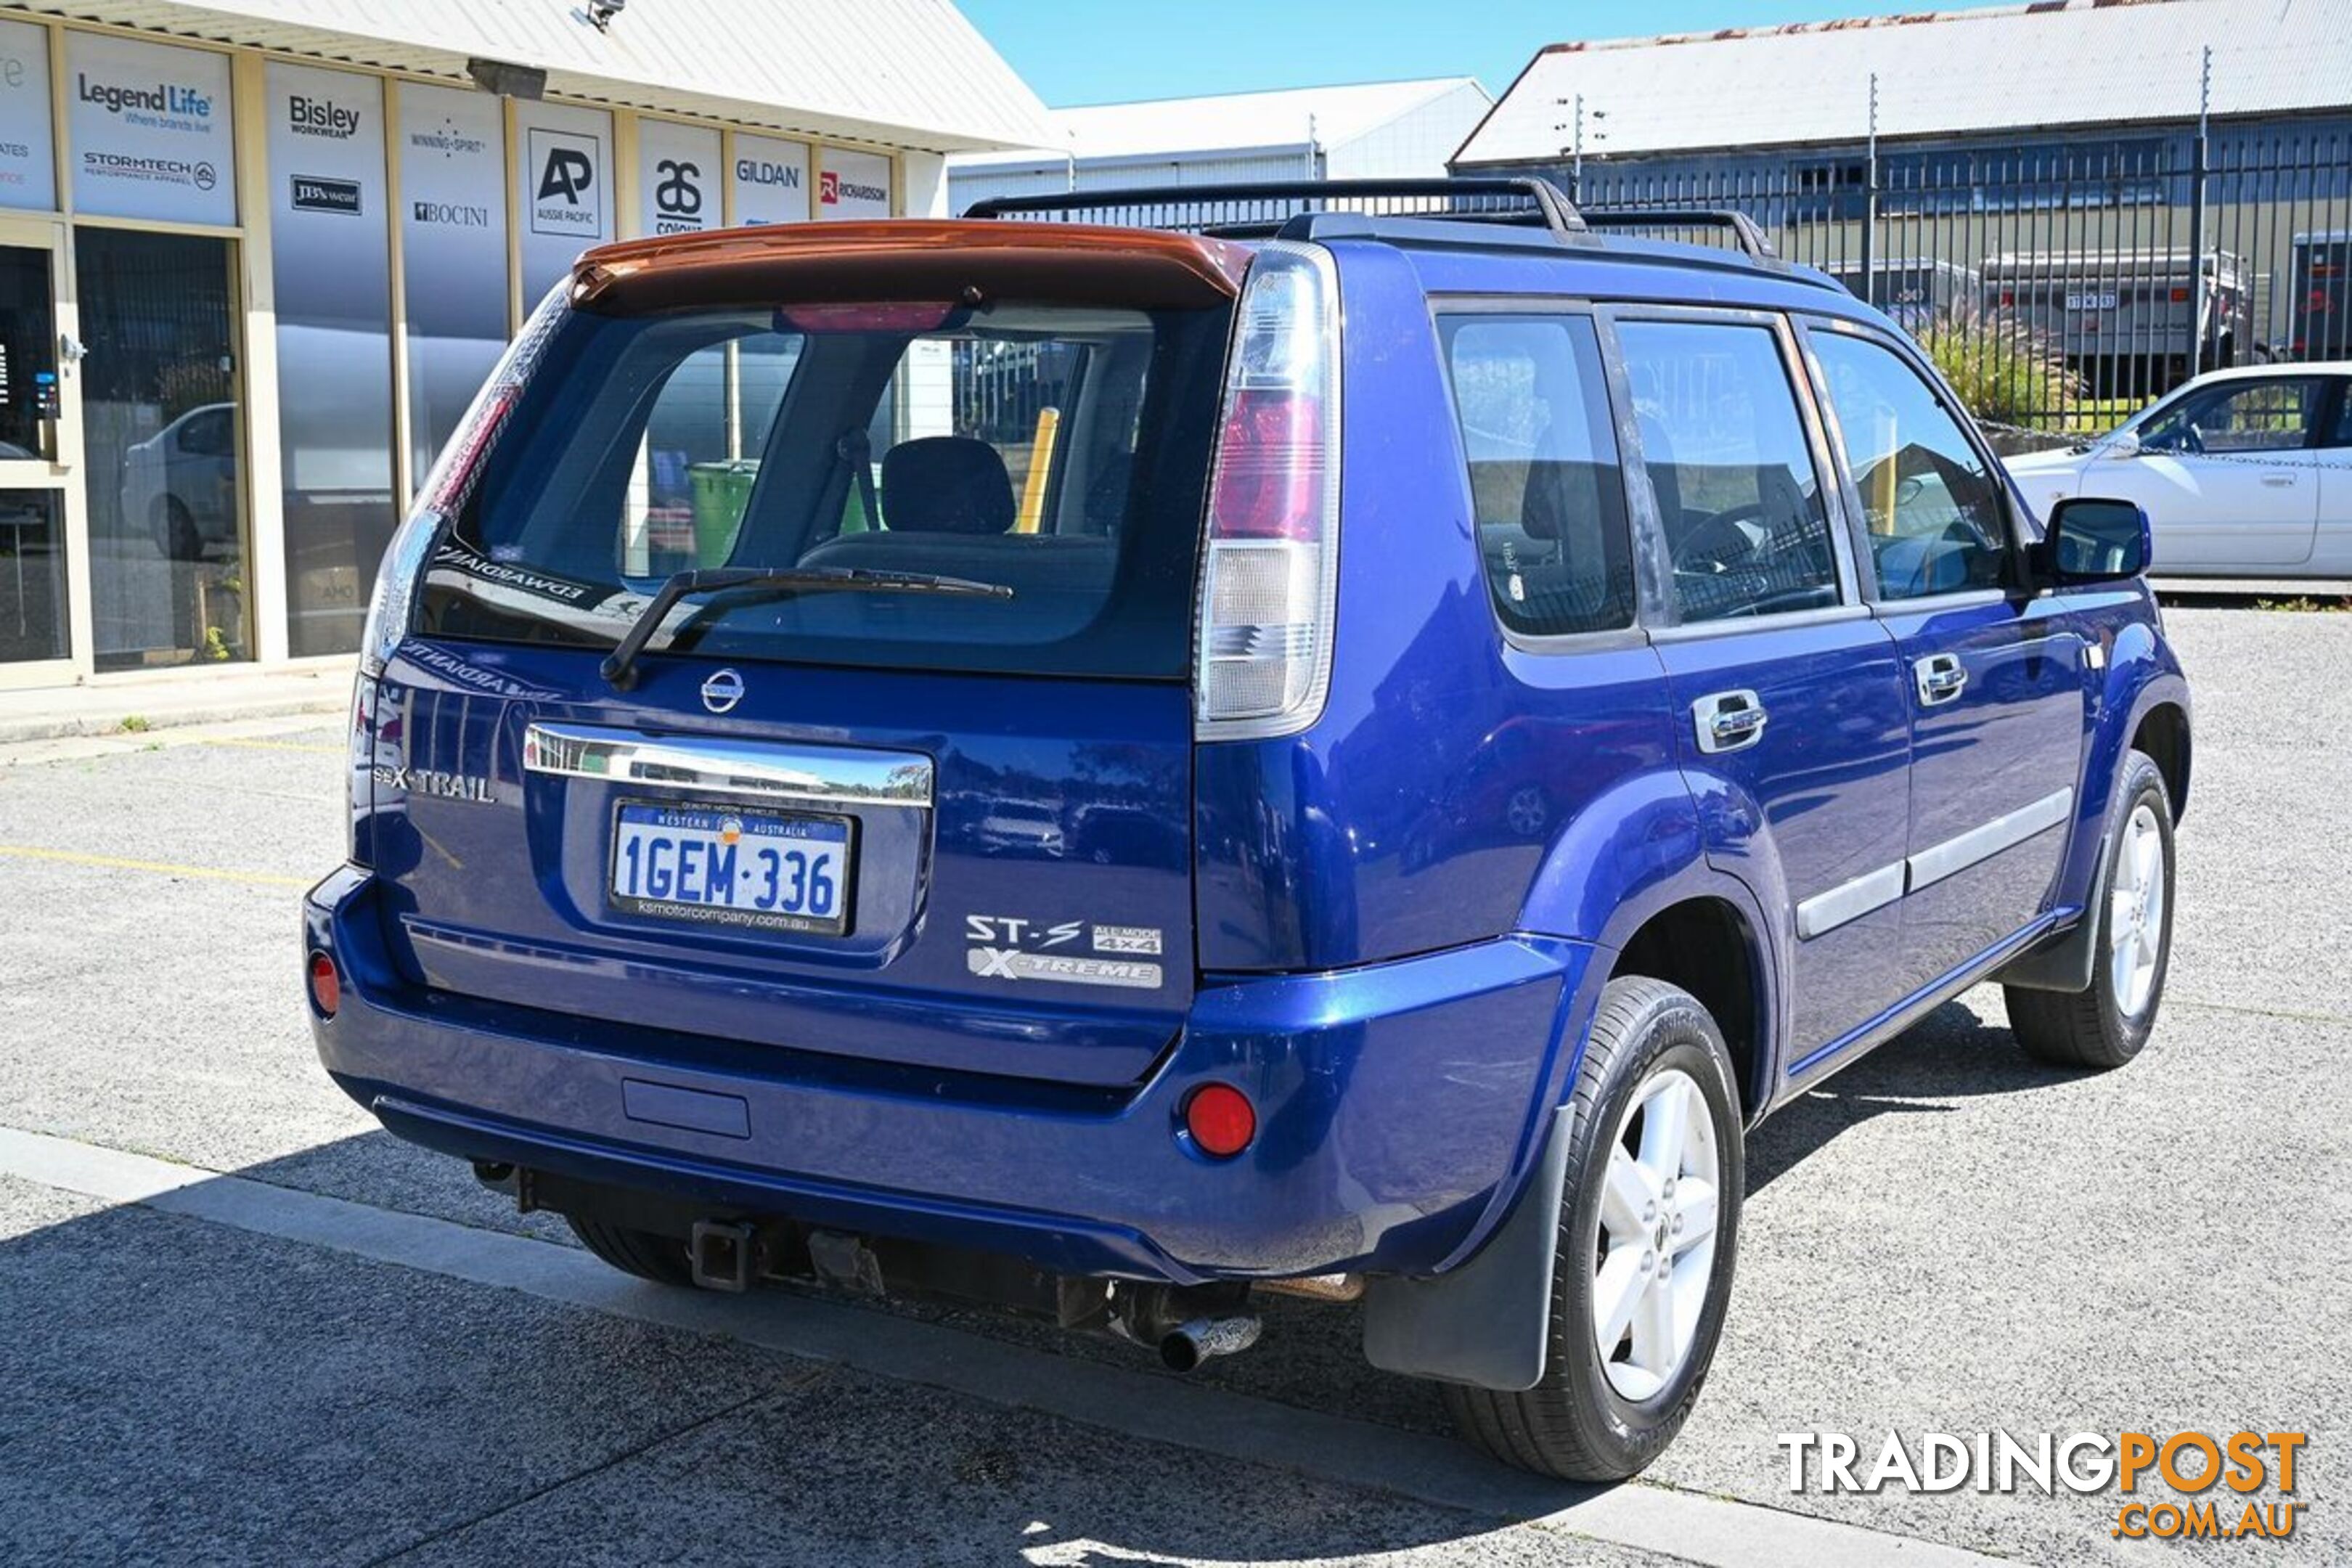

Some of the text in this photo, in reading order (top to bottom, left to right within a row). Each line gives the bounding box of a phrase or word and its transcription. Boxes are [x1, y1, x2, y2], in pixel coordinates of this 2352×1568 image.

[78, 73, 211, 117] Legend Life
[290, 95, 360, 135] Bisley
[291, 124, 348, 139] WORKWEAR
[84, 152, 191, 174] STORMTECH
[737, 159, 799, 189] GILDAN
[838, 182, 887, 202] RICHARDSON
[658, 814, 807, 838] WESTERN AUSTRALIA
[637, 901, 809, 931] ksmotorcompany.com.au
[976, 946, 1153, 980] X-TREME
